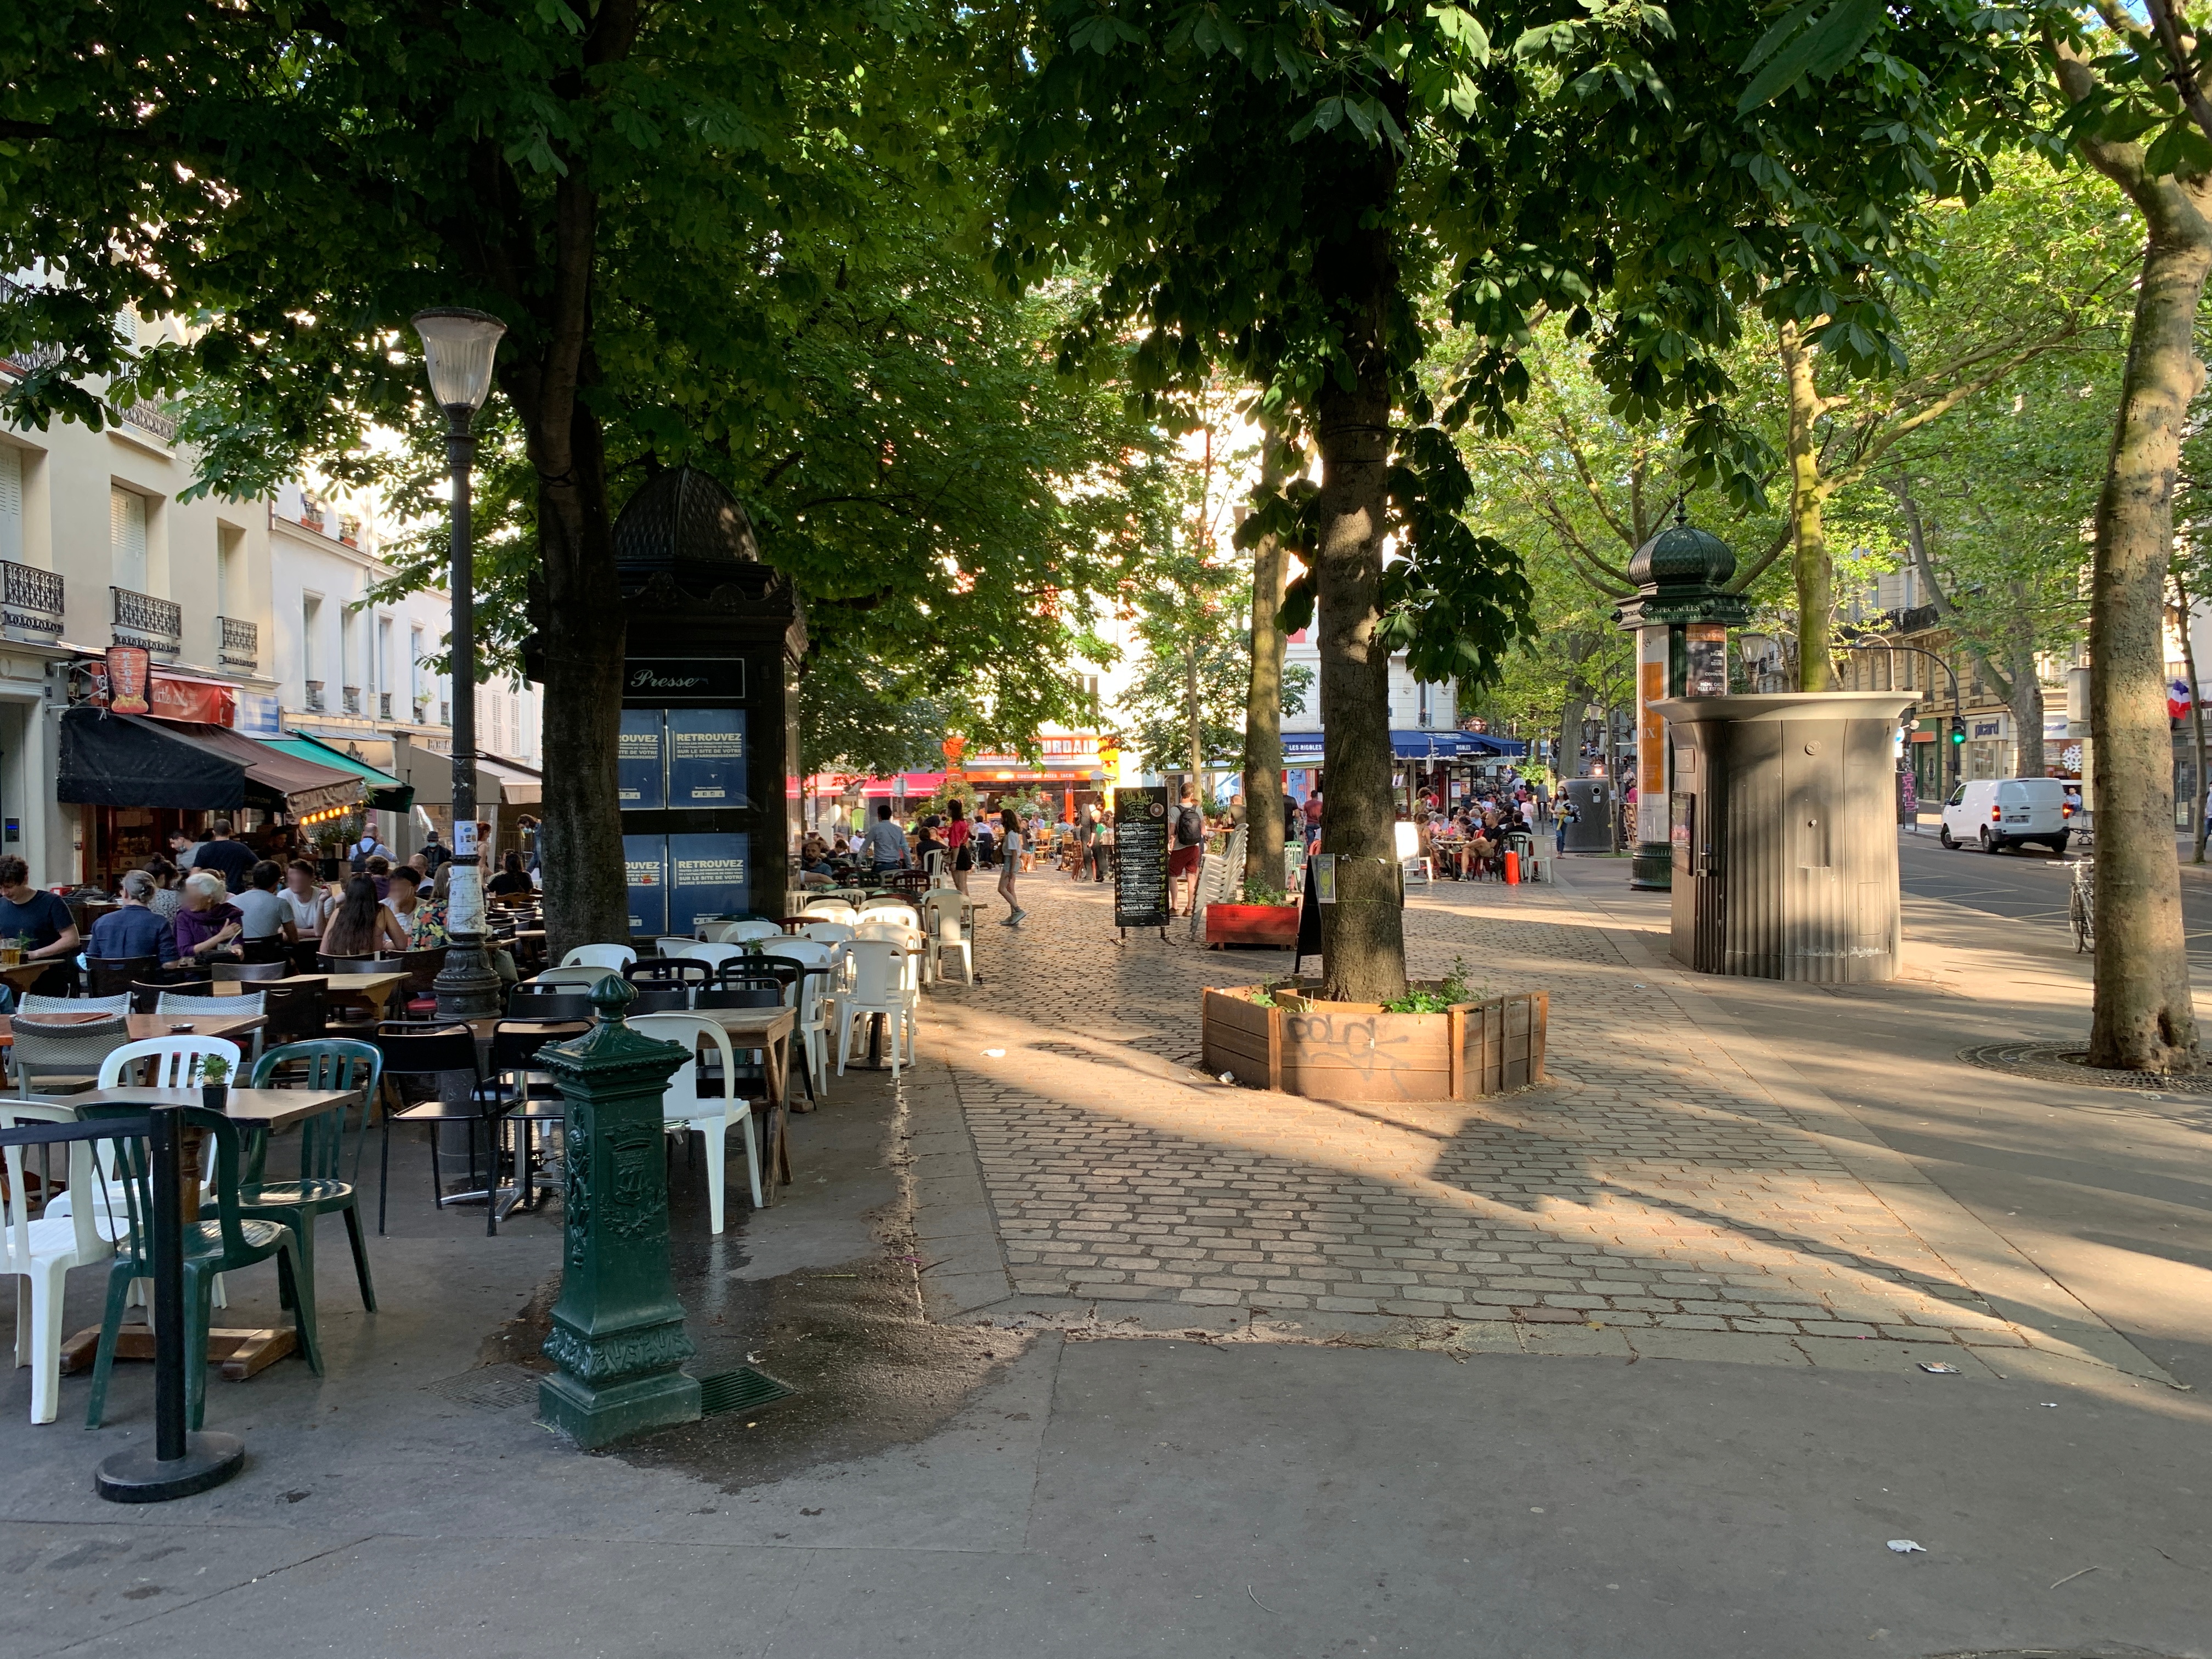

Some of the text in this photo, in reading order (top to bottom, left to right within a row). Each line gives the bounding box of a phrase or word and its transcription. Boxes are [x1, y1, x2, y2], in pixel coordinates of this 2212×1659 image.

[123, 651, 133, 694] KEBAB
[631, 669, 699, 687] Presse
[1975, 719, 1999, 738] picard
[679, 860, 743, 868] RETROUVEZ
